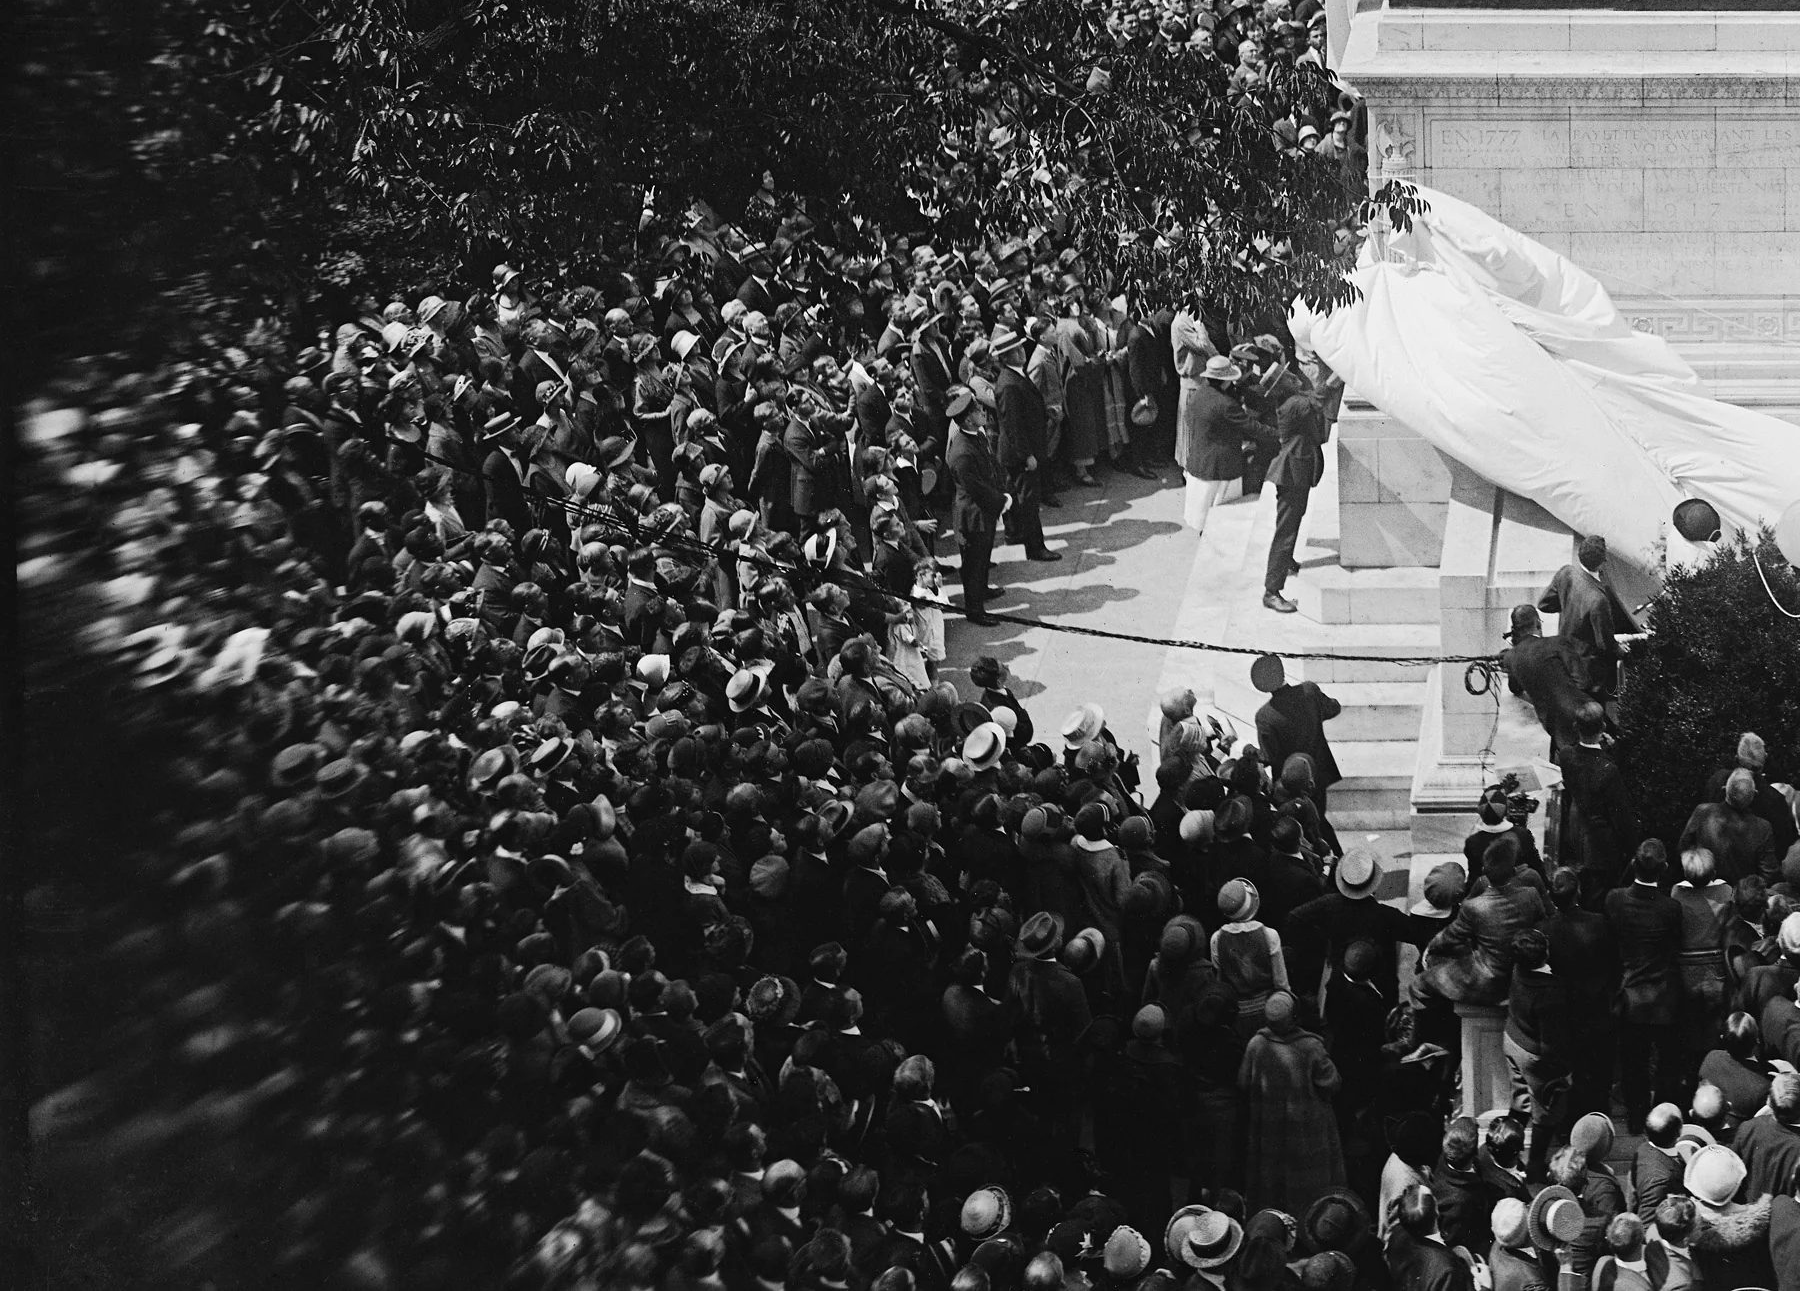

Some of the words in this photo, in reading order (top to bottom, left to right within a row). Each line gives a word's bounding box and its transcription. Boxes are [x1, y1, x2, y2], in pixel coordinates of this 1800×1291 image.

[1441, 129, 1470, 146] EN
[1478, 129, 1521, 146] 1777
[1542, 129, 1559, 140] LA
[1573, 129, 1639, 140] FAYETTE
[1652, 129, 1755, 140] TRAVERSANT
[1764, 129, 1792, 140] LES
[1592, 142, 1620, 154] DES
[1679, 156, 1715, 167] AIDE
[1563, 203, 1599, 218] EN
[1645, 203, 1721, 218] 1917
